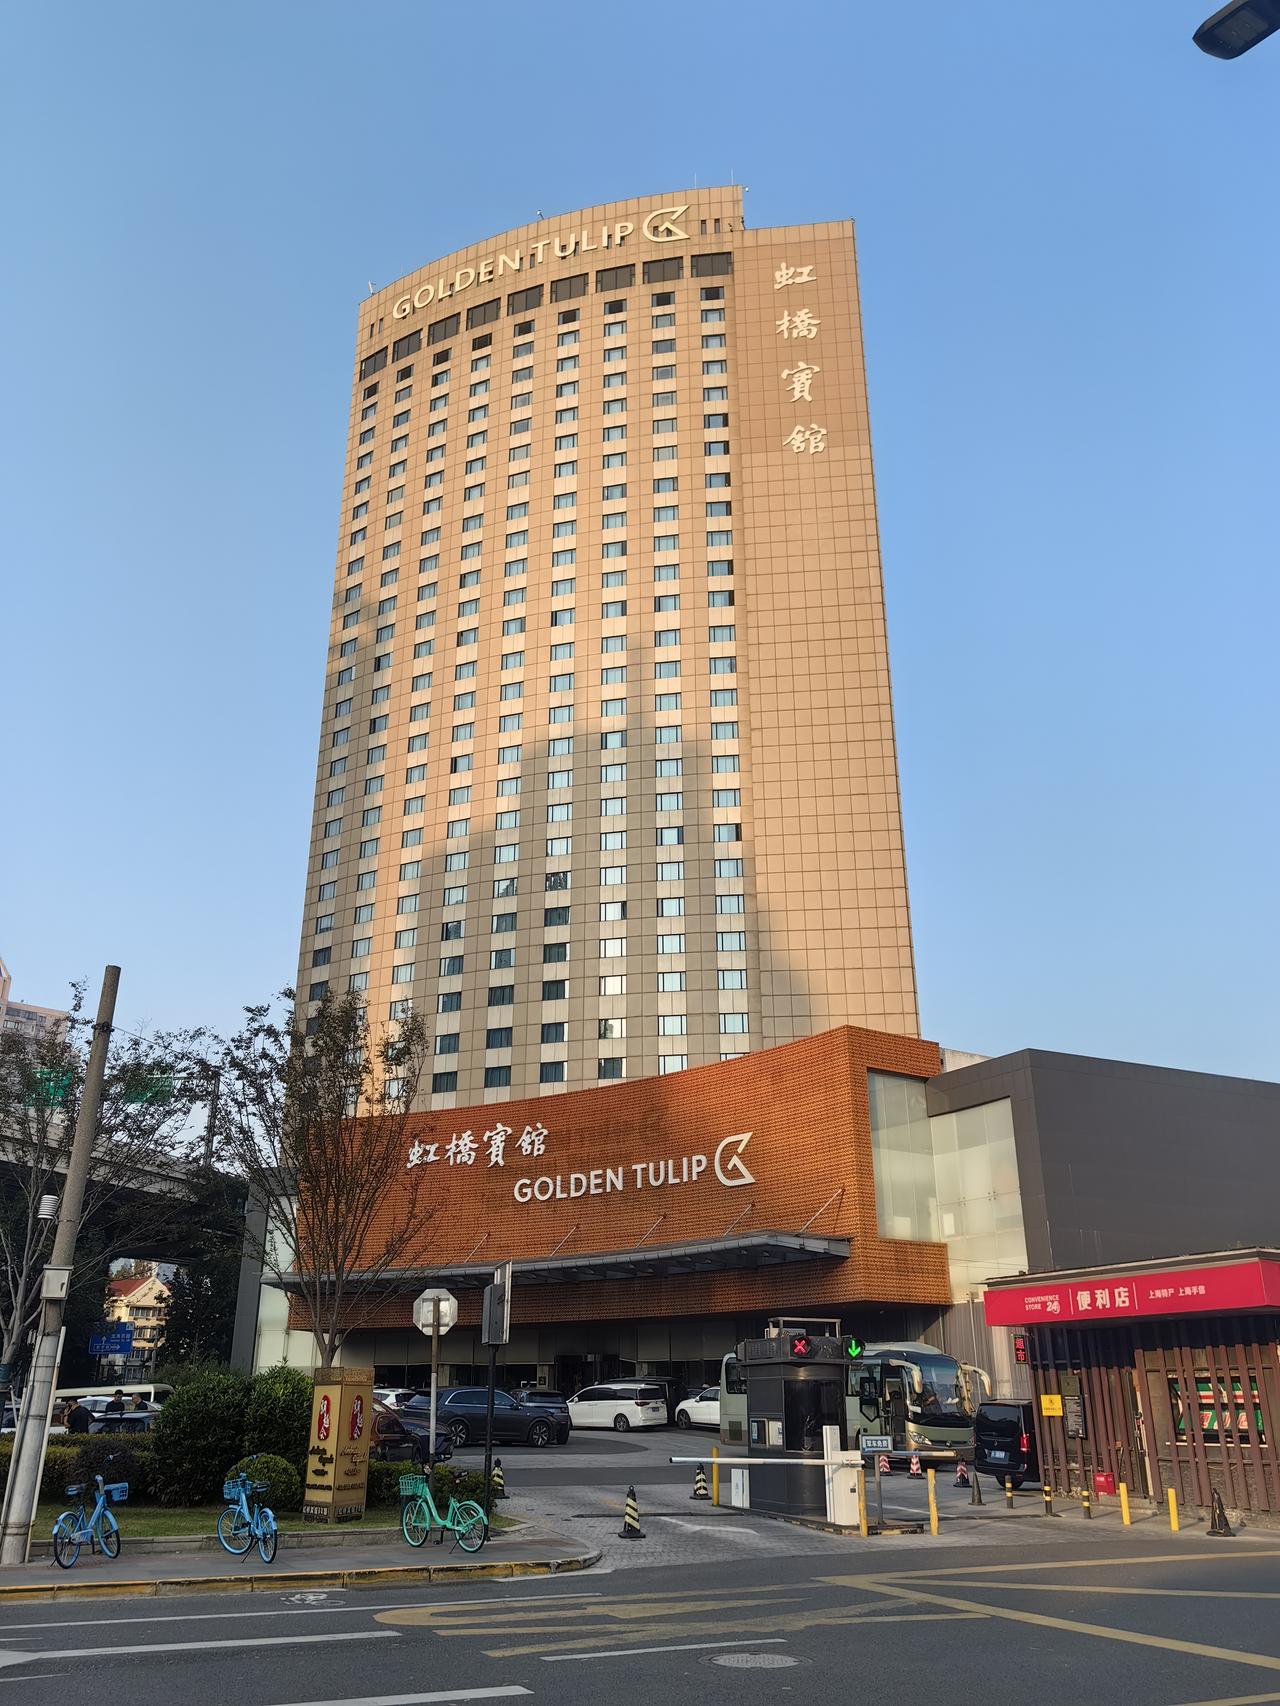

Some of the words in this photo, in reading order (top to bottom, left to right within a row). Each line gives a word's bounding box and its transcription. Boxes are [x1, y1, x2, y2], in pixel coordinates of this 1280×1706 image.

[392, 249, 521, 320] GOLDEN
[531, 221, 634, 264] TULIP
[513, 1167, 624, 1203] GOLDEN
[631, 1154, 708, 1189] TULIP
[1024, 1294, 1060, 1304] CONVENIENCE
[1025, 1303, 1042, 1311] STORE
[1076, 1286, 1130, 1311] 便利店
[1015, 1337, 1025, 1361] 超市
